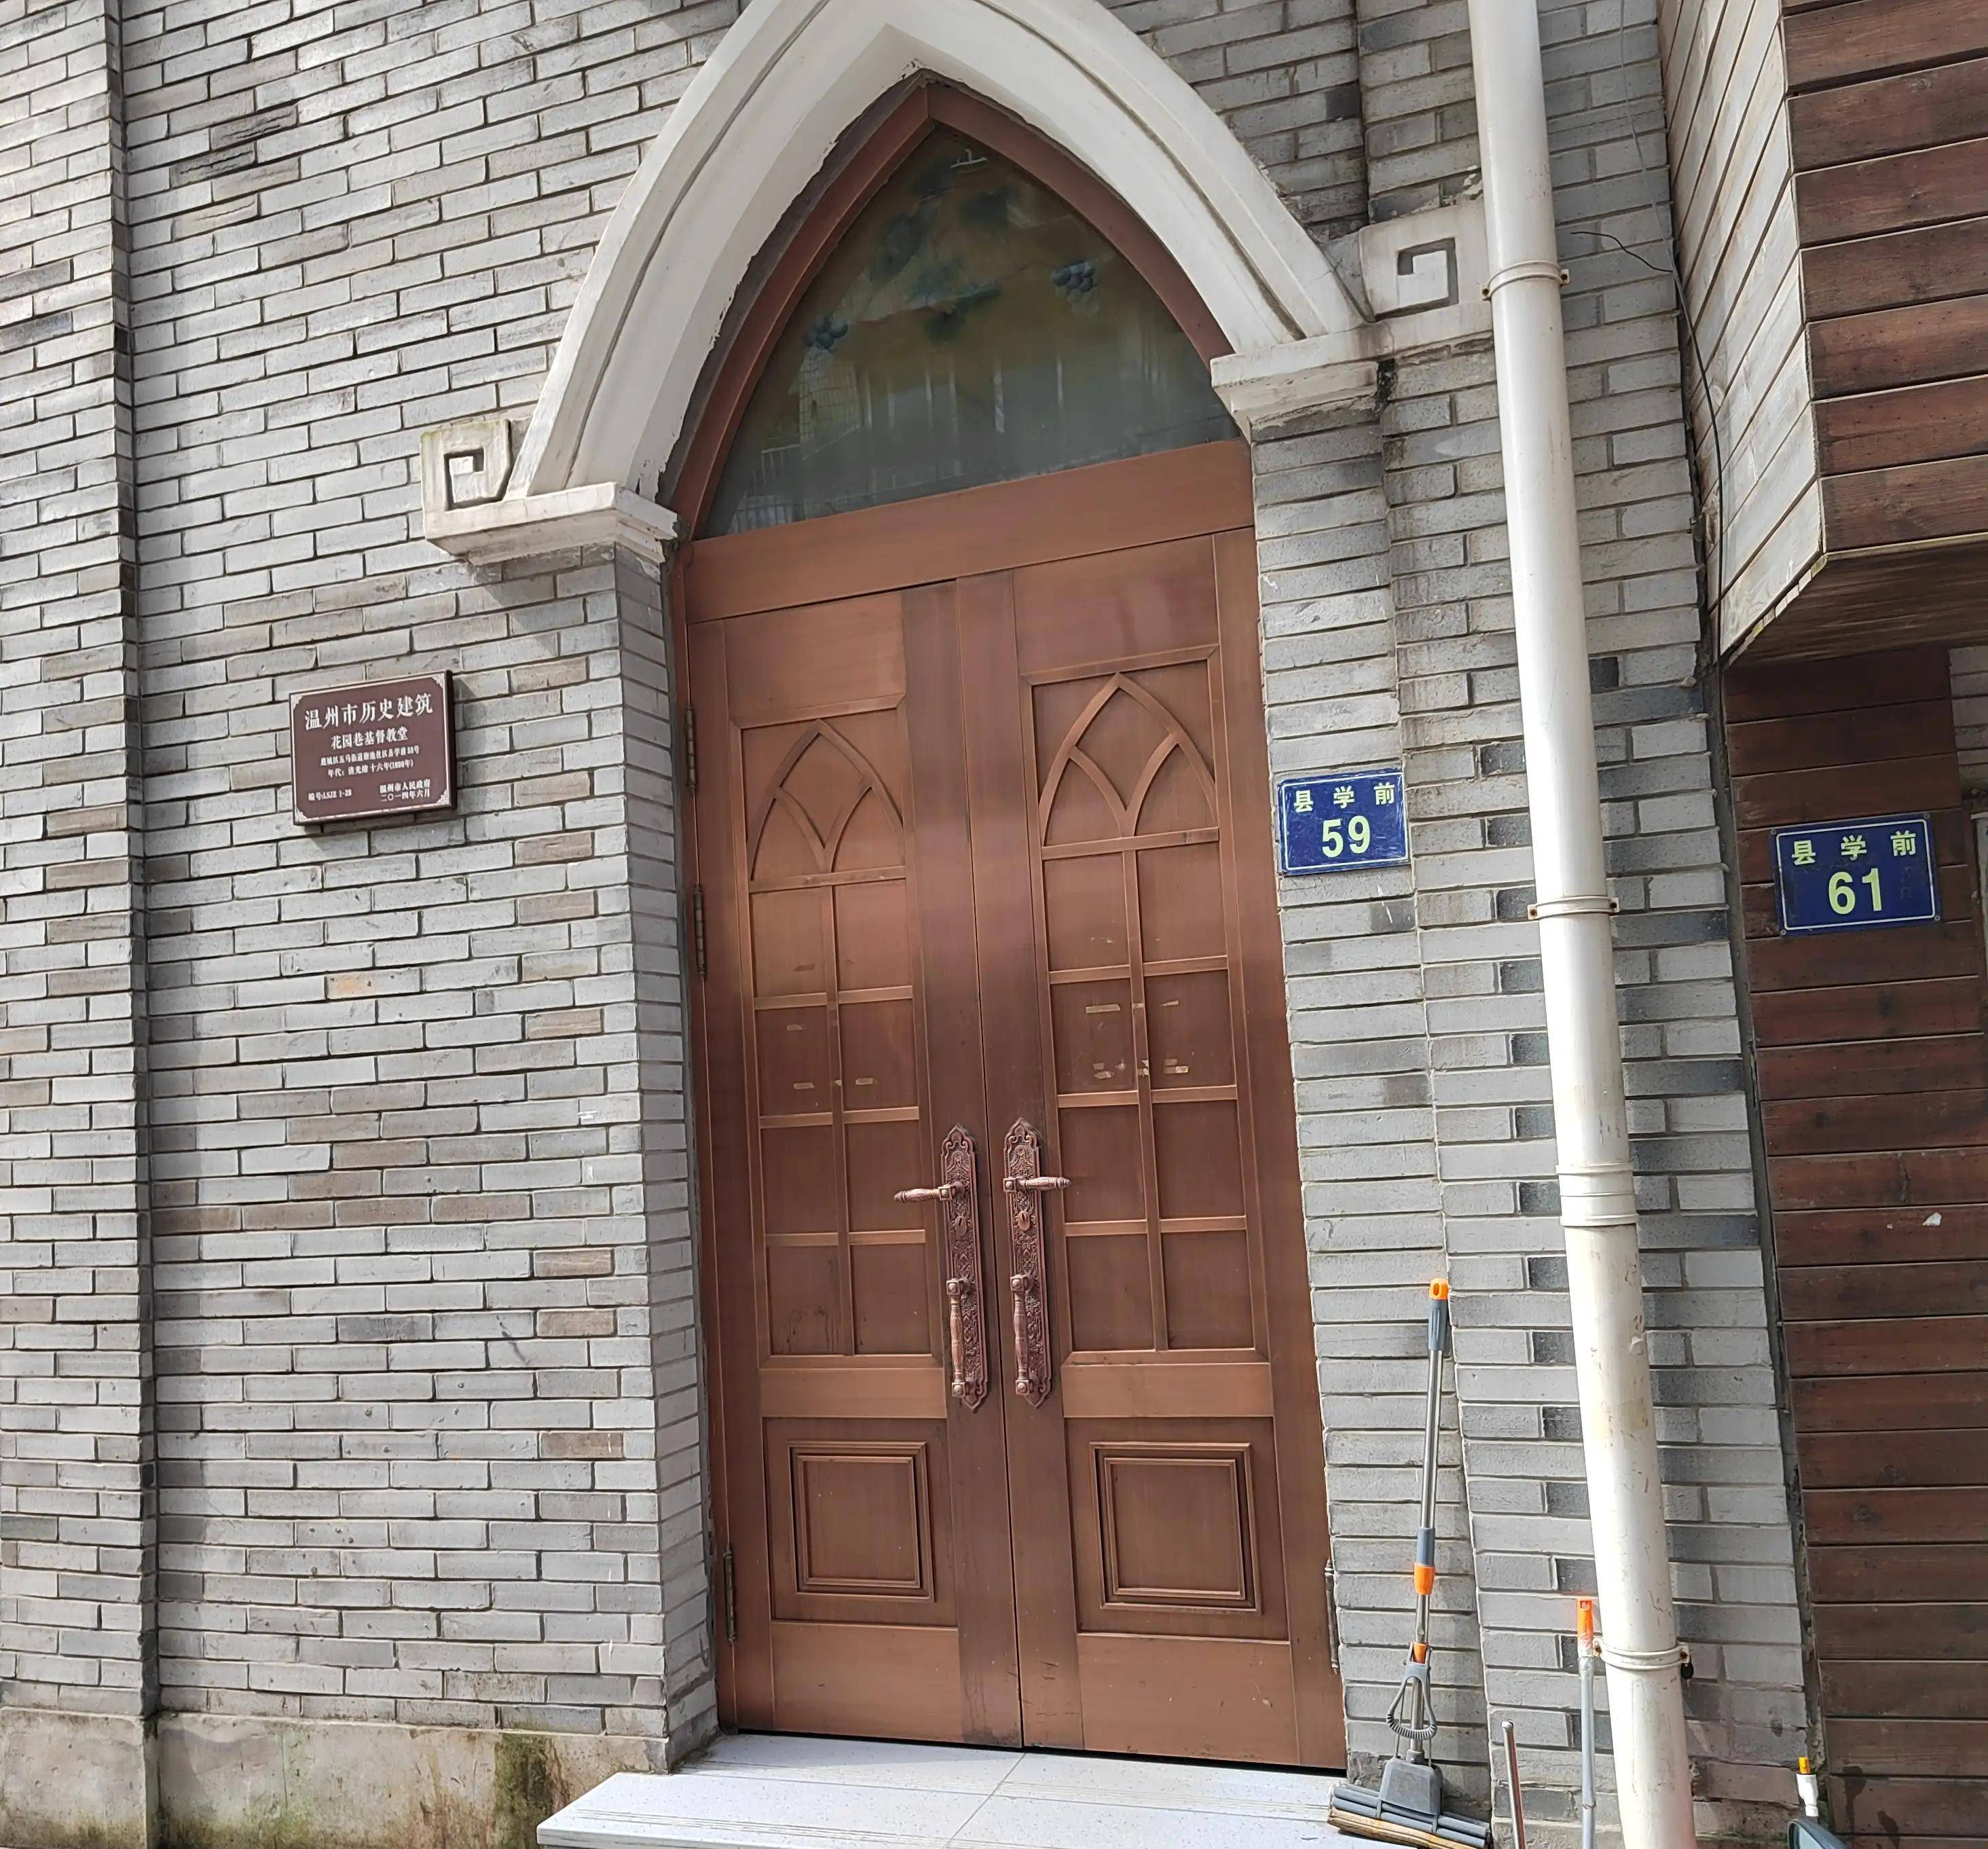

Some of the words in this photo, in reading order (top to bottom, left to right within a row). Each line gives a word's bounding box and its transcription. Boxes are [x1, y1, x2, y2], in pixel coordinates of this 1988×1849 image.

[305, 693, 433, 731] 温州市历史建筑
[331, 726, 408, 750] 花园巷基督教堂
[380, 779, 430, 793] 温州市人民政府
[1293, 782, 1395, 813] 县学前
[1322, 815, 1371, 858] 59
[1791, 830, 1916, 866] 县学前
[1828, 868, 1882, 915] 61
